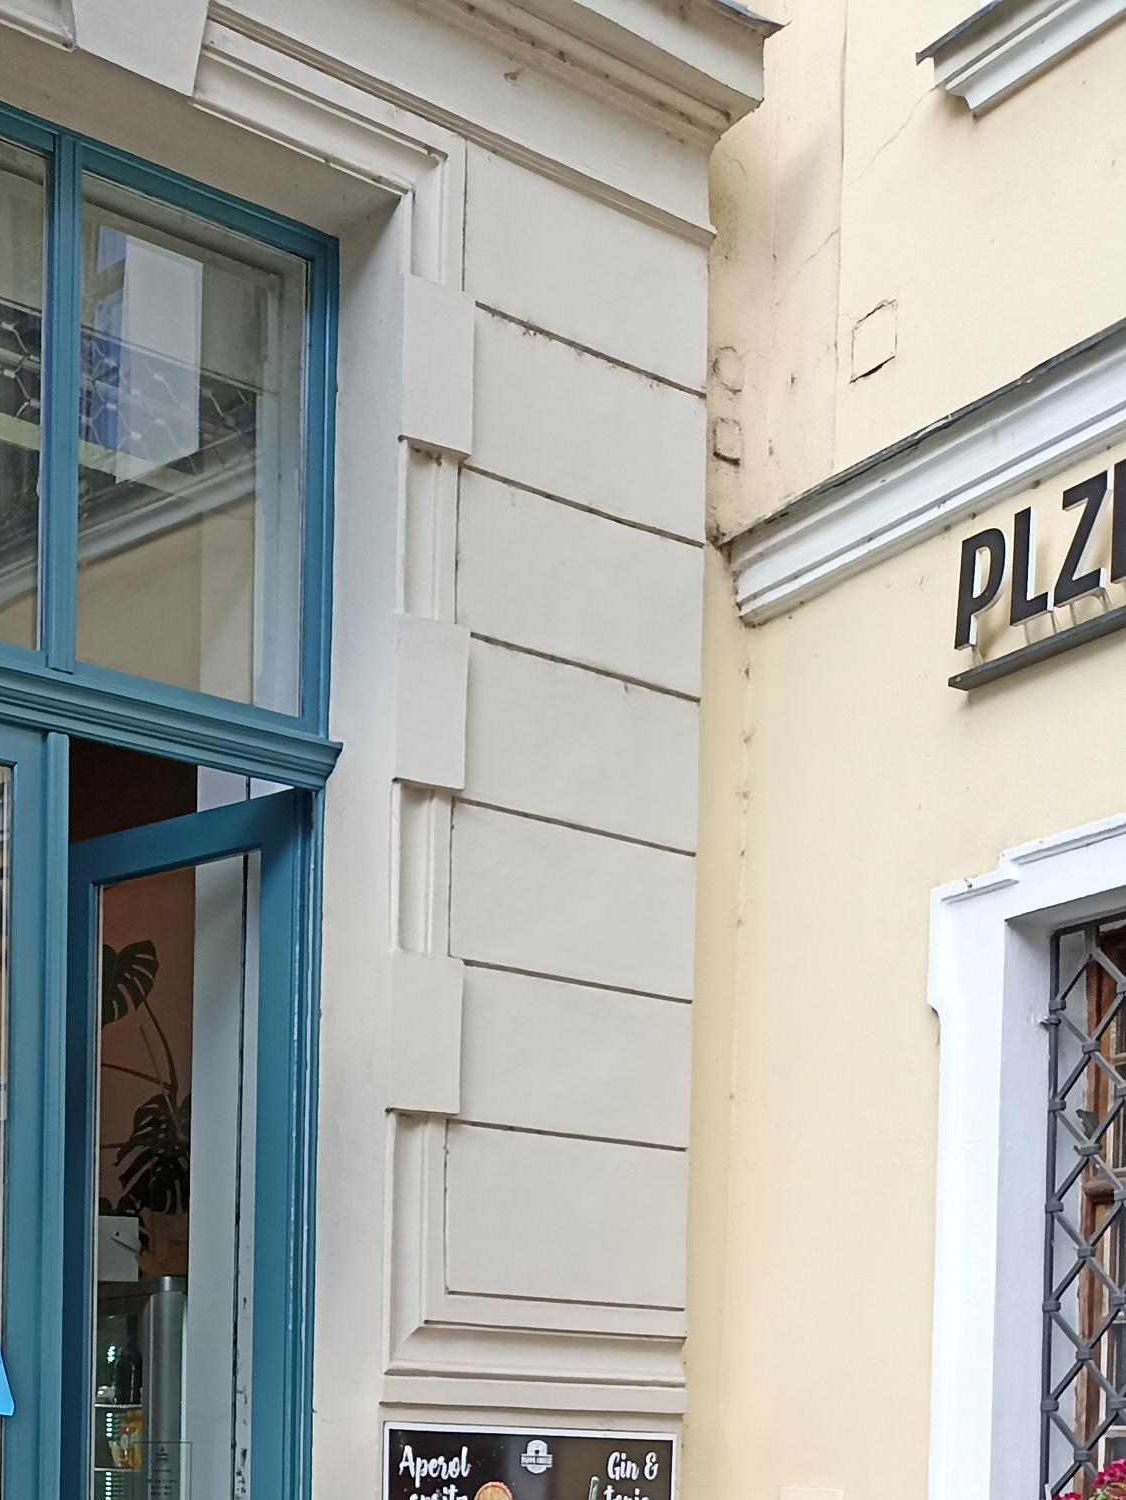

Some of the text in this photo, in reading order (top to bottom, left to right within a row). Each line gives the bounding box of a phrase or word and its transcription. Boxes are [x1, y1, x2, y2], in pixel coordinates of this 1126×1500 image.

[954, 457, 1126, 651] PLZ
[398, 1445, 471, 1487] Aperol
[606, 1451, 659, 1480] Gin &
